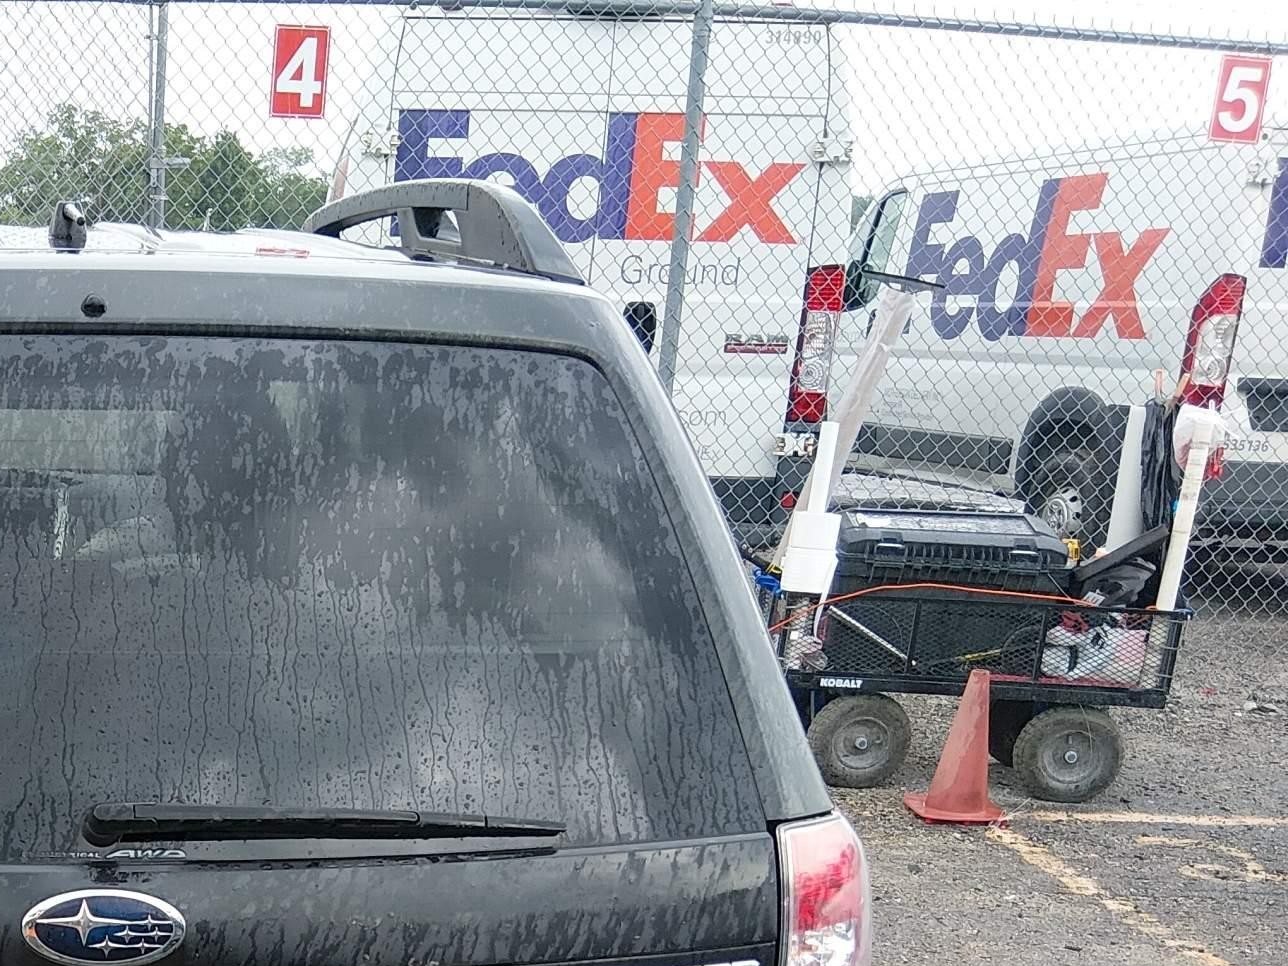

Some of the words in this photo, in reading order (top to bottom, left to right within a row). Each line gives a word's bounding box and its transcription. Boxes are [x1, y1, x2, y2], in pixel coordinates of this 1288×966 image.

[275, 36, 323, 108] 4
[1217, 66, 1262, 133] 5
[901, 172, 1171, 342] FedEx
[819, 677, 863, 689] KOBALT
